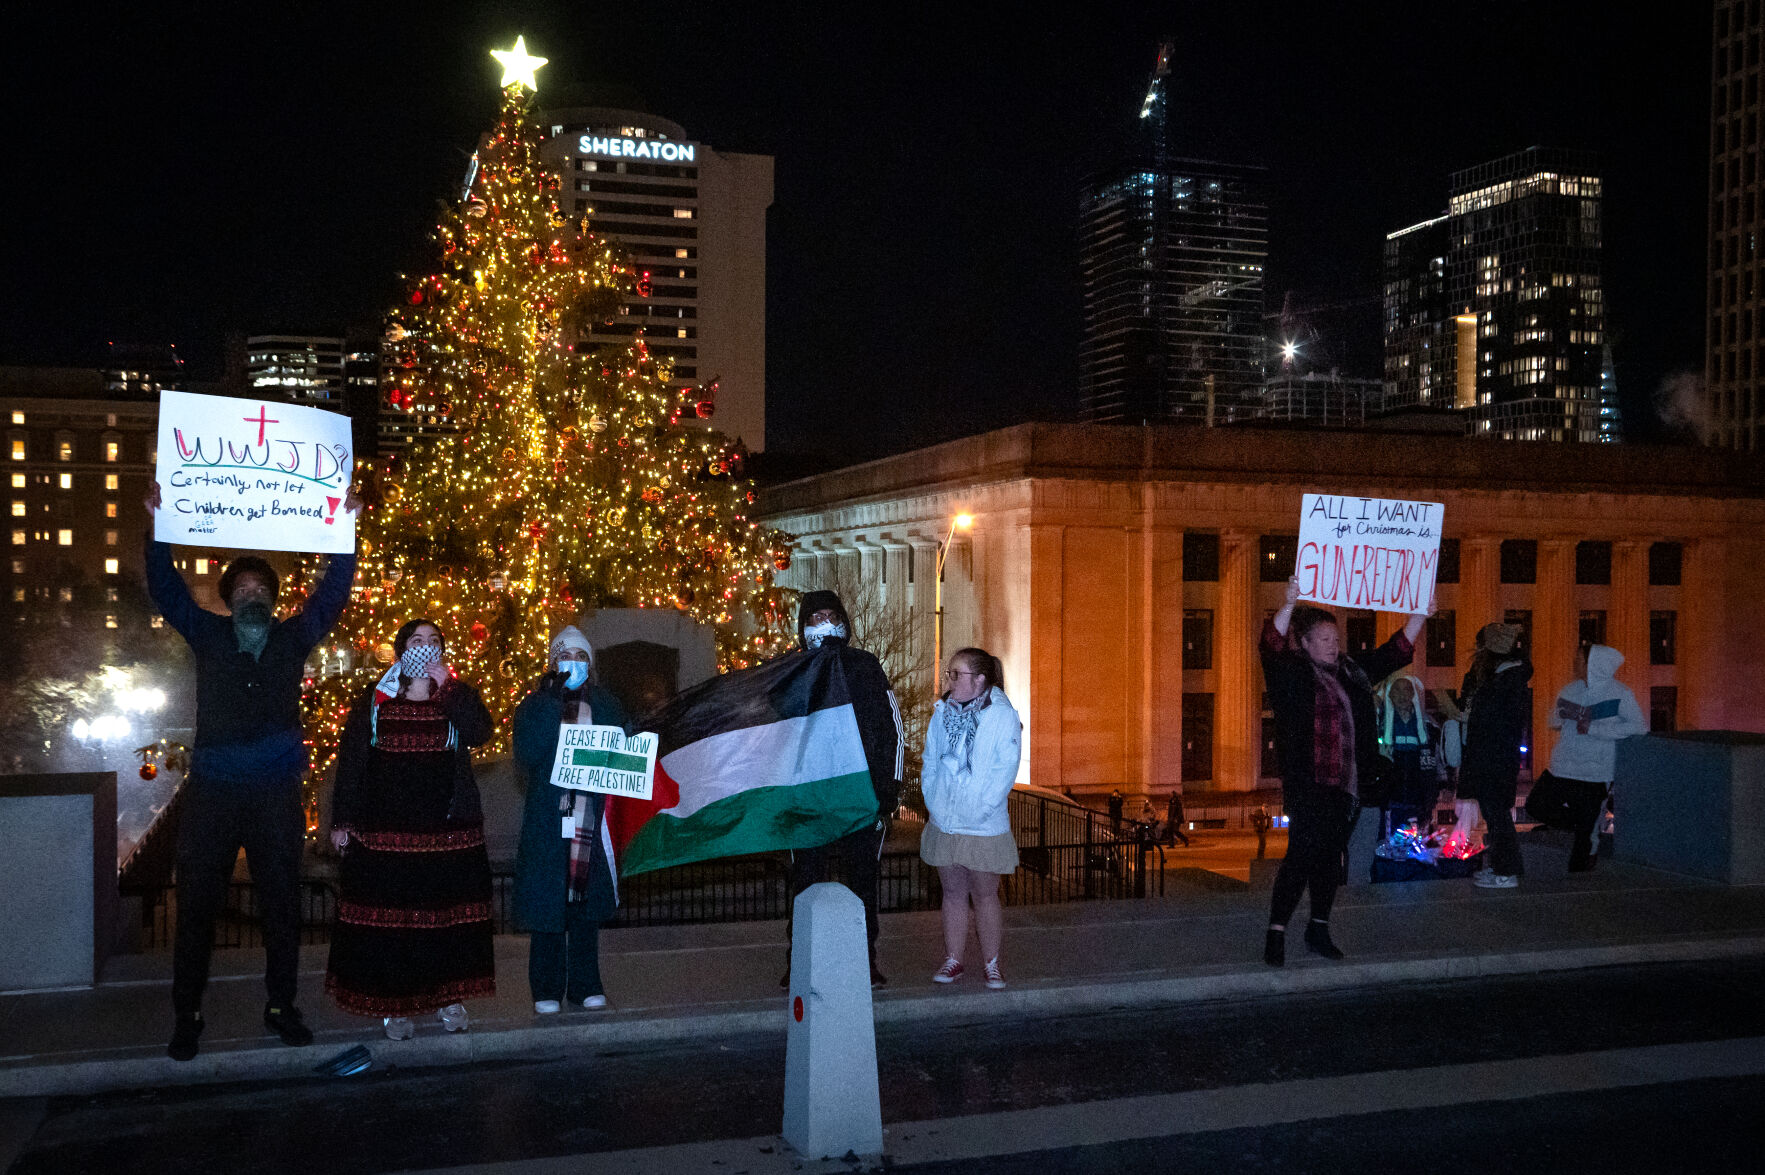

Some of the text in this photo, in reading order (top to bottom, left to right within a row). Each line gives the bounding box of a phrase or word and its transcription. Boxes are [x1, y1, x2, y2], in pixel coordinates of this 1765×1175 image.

[579, 135, 694, 161] SHERATON
[174, 427, 349, 483] WWJD?
[170, 471, 305, 494] Certainly not let
[174, 498, 244, 516] Children
[247, 504, 267, 521] get
[1309, 495, 1433, 523] ALL I WANT
[1331, 521, 1351, 538] for
[1356, 521, 1416, 535] Christmas
[565, 729, 651, 754] CEASE FIRE NOW
[562, 748, 570, 765] &
[557, 766, 646, 793] FREE PALESTINE!
